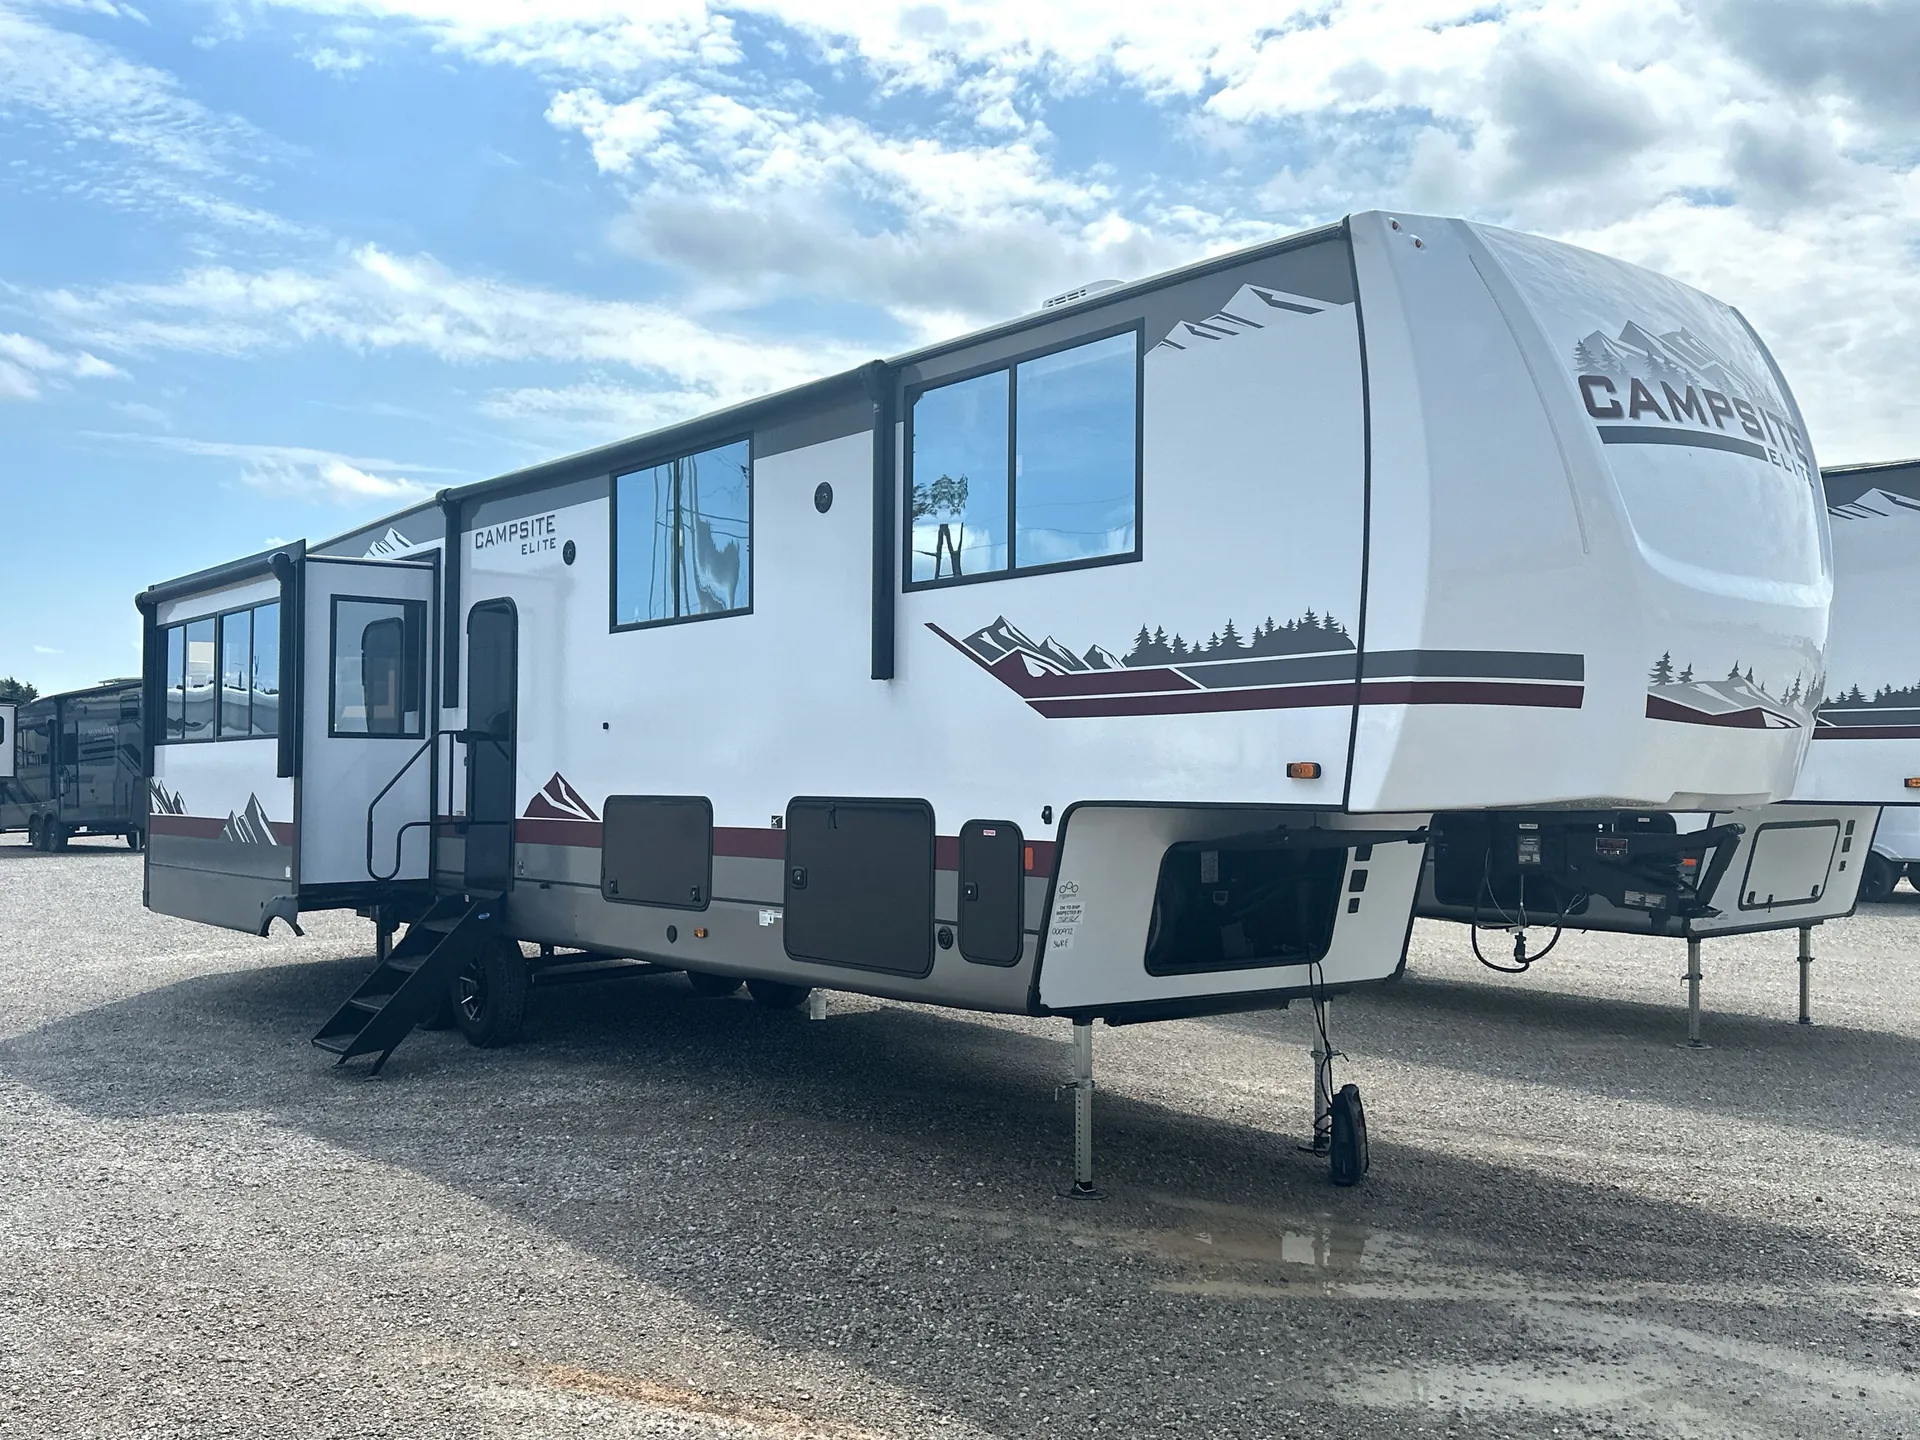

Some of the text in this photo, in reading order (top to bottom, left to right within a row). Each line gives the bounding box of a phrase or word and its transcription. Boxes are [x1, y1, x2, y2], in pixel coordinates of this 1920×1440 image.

[1578, 375, 1809, 468] CAMPSITE
[1767, 447, 1814, 489] ELITE
[475, 514, 556, 549] CAMPSITE
[521, 537, 556, 555] ELITE
[87, 725, 120, 736] MONTANA
